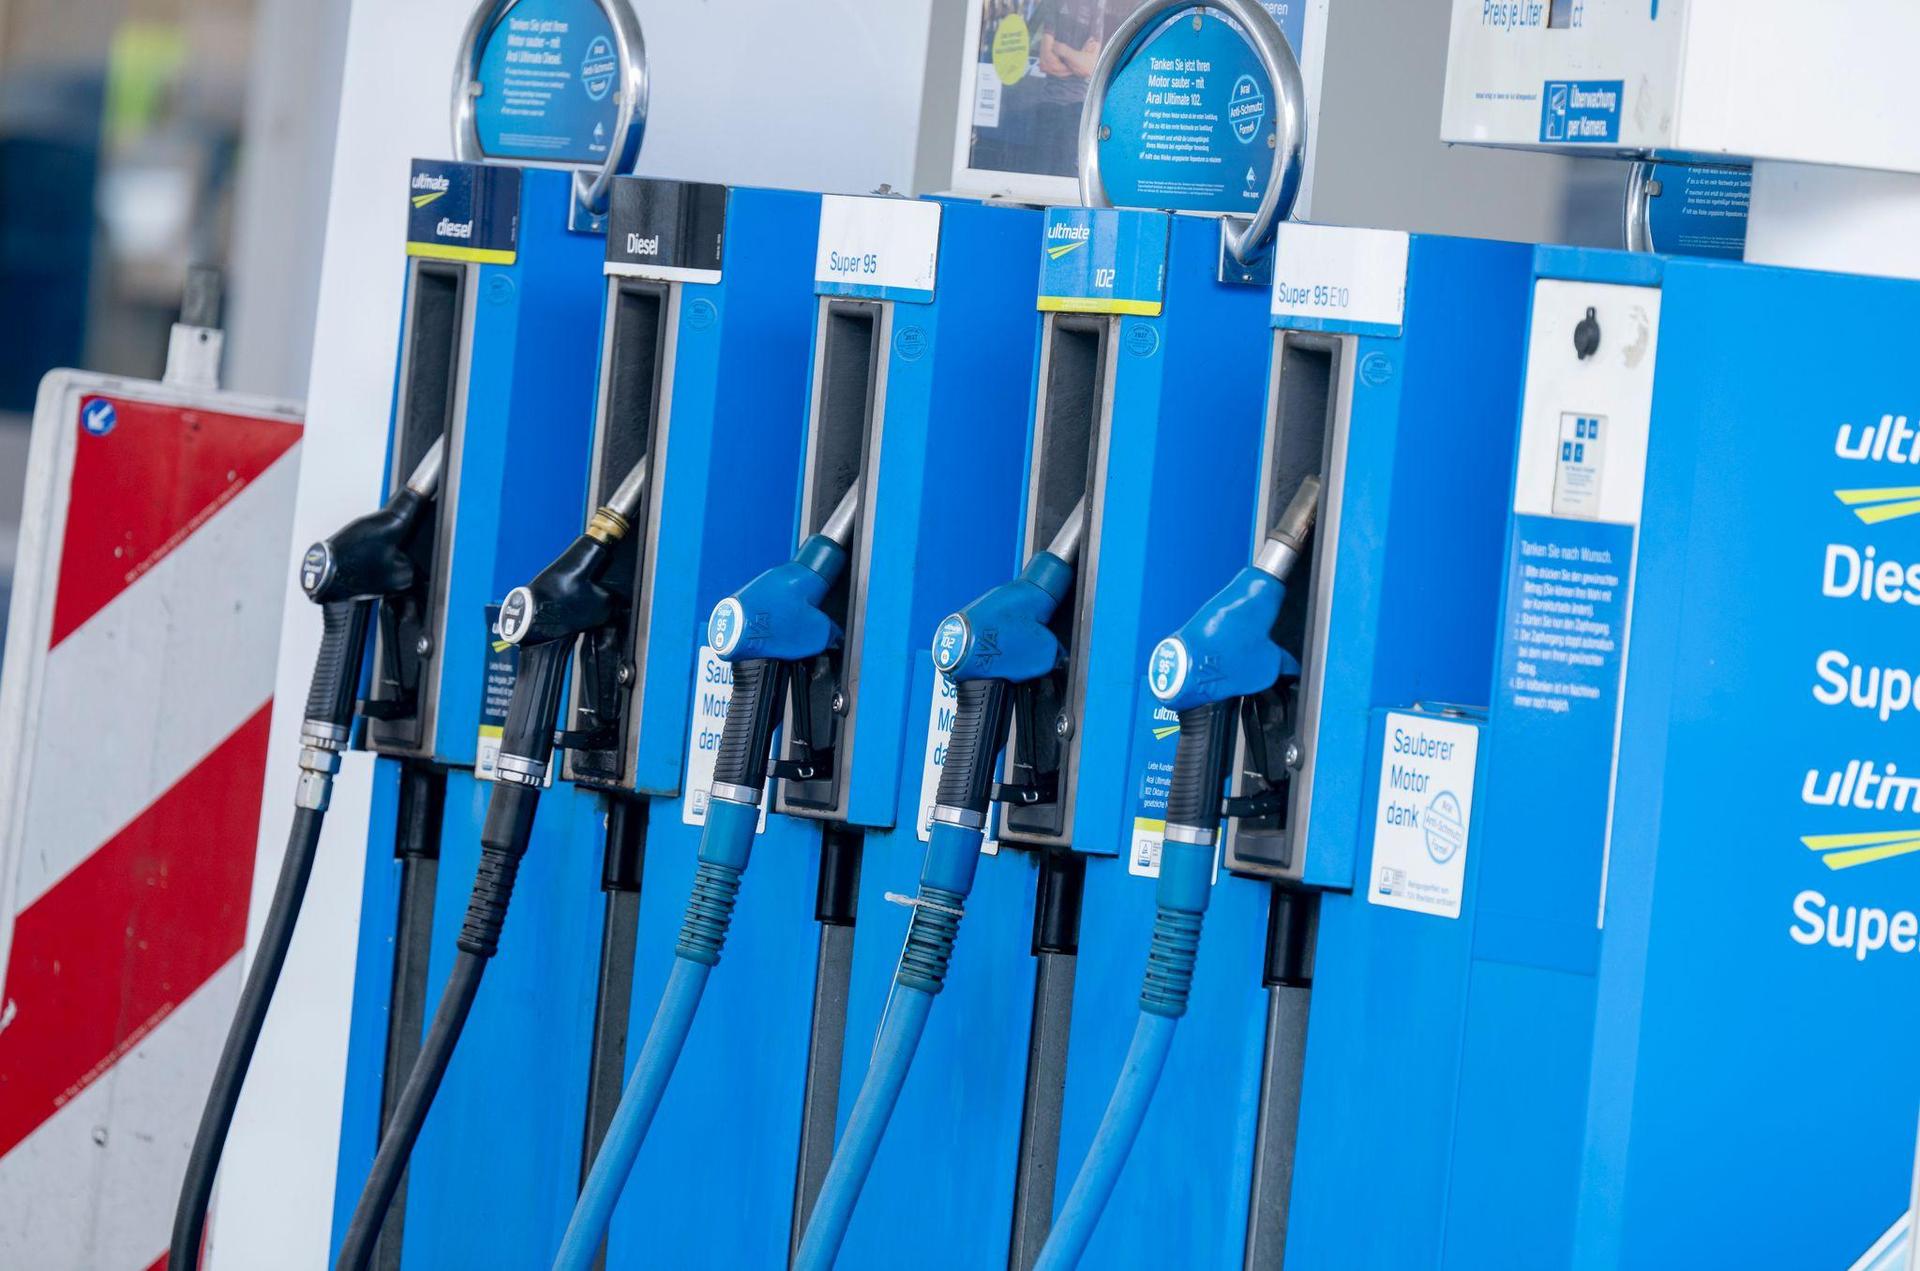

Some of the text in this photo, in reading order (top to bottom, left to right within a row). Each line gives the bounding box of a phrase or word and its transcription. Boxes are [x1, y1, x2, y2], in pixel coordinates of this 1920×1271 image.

[1482, 0, 1543, 32] Preis je Liter
[1150, 58, 1174, 71] Tanken
[1175, 58, 1184, 71] Sie
[1196, 60, 1210, 72] Ihren
[1148, 74, 1170, 88] Motor
[1171, 76, 1190, 88] sauber
[1240, 84, 1250, 96] Aral
[1146, 92, 1162, 105] Aral
[1164, 92, 1190, 106] Ultimate
[1230, 102, 1263, 118] Anti-Schmutz
[1570, 84, 1616, 112] Überwachung
[1567, 116, 1608, 140] per Kamera.
[412, 173, 449, 191] ultimate
[436, 216, 472, 239] diesel
[1048, 222, 1090, 240] ultimate
[627, 233, 658, 256] Diesel
[830, 252, 877, 276] Super 95
[1095, 268, 1116, 288] 102
[1278, 282, 1349, 308] Super 95 E10
[1834, 414, 1920, 465] ulti
[1822, 544, 1920, 606] Dies
[716, 618, 728, 632] 95
[940, 636, 956, 649] 102
[1812, 650, 1920, 722] Sup
[1393, 728, 1454, 761] Sauberer
[1390, 764, 1430, 794] Motor
[1802, 759, 1920, 814] ultim
[1386, 800, 1418, 828] dank
[1789, 890, 1920, 962] Supe
